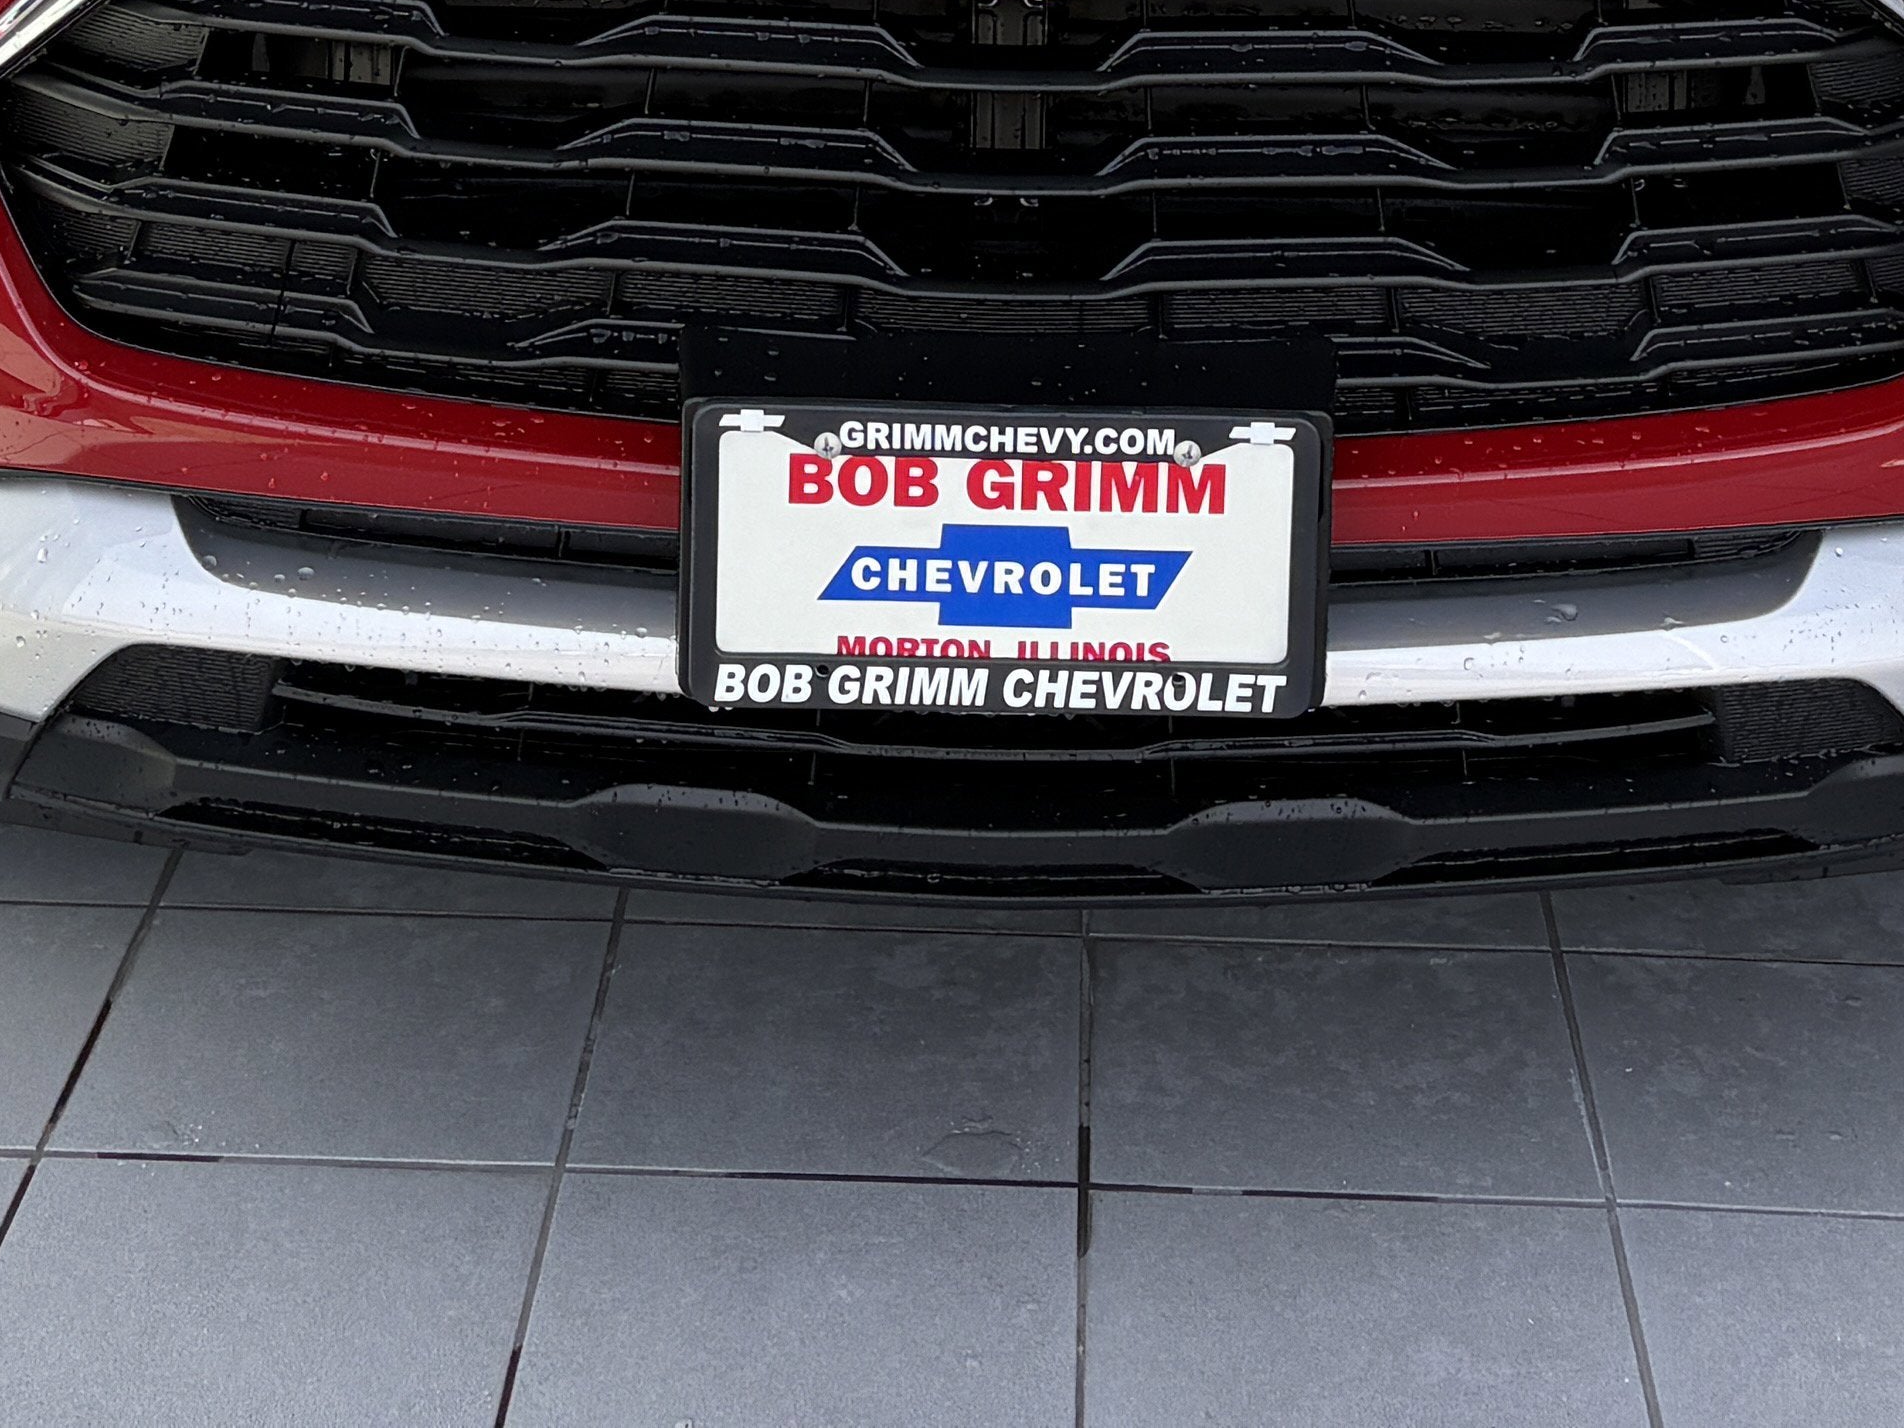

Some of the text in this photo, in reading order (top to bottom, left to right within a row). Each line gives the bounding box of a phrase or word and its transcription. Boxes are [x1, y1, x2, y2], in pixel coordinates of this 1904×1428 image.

[839, 420, 1176, 457] GRIMMCHEVY.COM
[788, 452, 1227, 515] BOB GRIMM
[850, 556, 1157, 598] CHEVROLET
[836, 635, 992, 660] MORTON
[714, 663, 1288, 713] BOB GRIMM CHEVROLET
